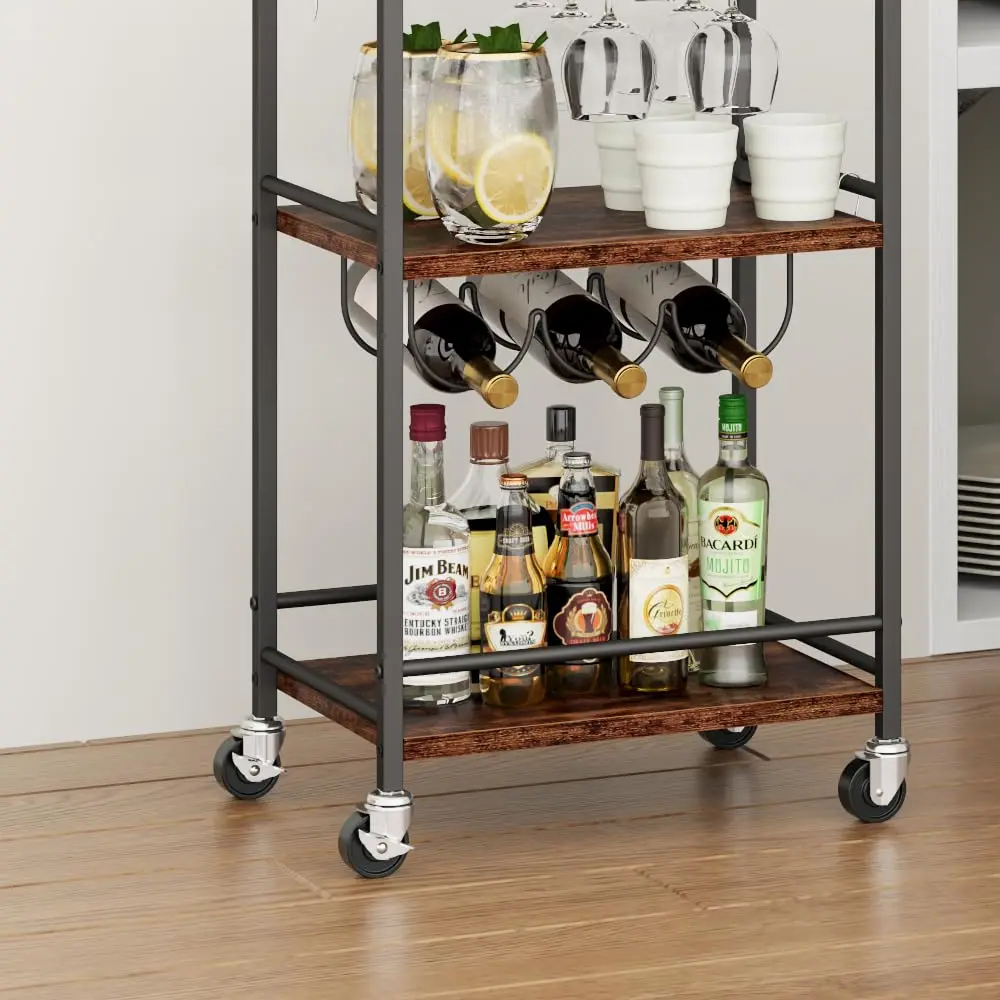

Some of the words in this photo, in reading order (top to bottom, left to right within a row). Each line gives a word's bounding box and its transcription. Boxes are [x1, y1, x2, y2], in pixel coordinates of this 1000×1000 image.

[405, 564, 433, 585] JIM
[437, 560, 469, 580] BEAM
[706, 557, 750, 574] MOJITO
[404, 617, 441, 628] ENTUCKY
[444, 614, 468, 627] STRAIG
[444, 623, 468, 635] WHISKE
